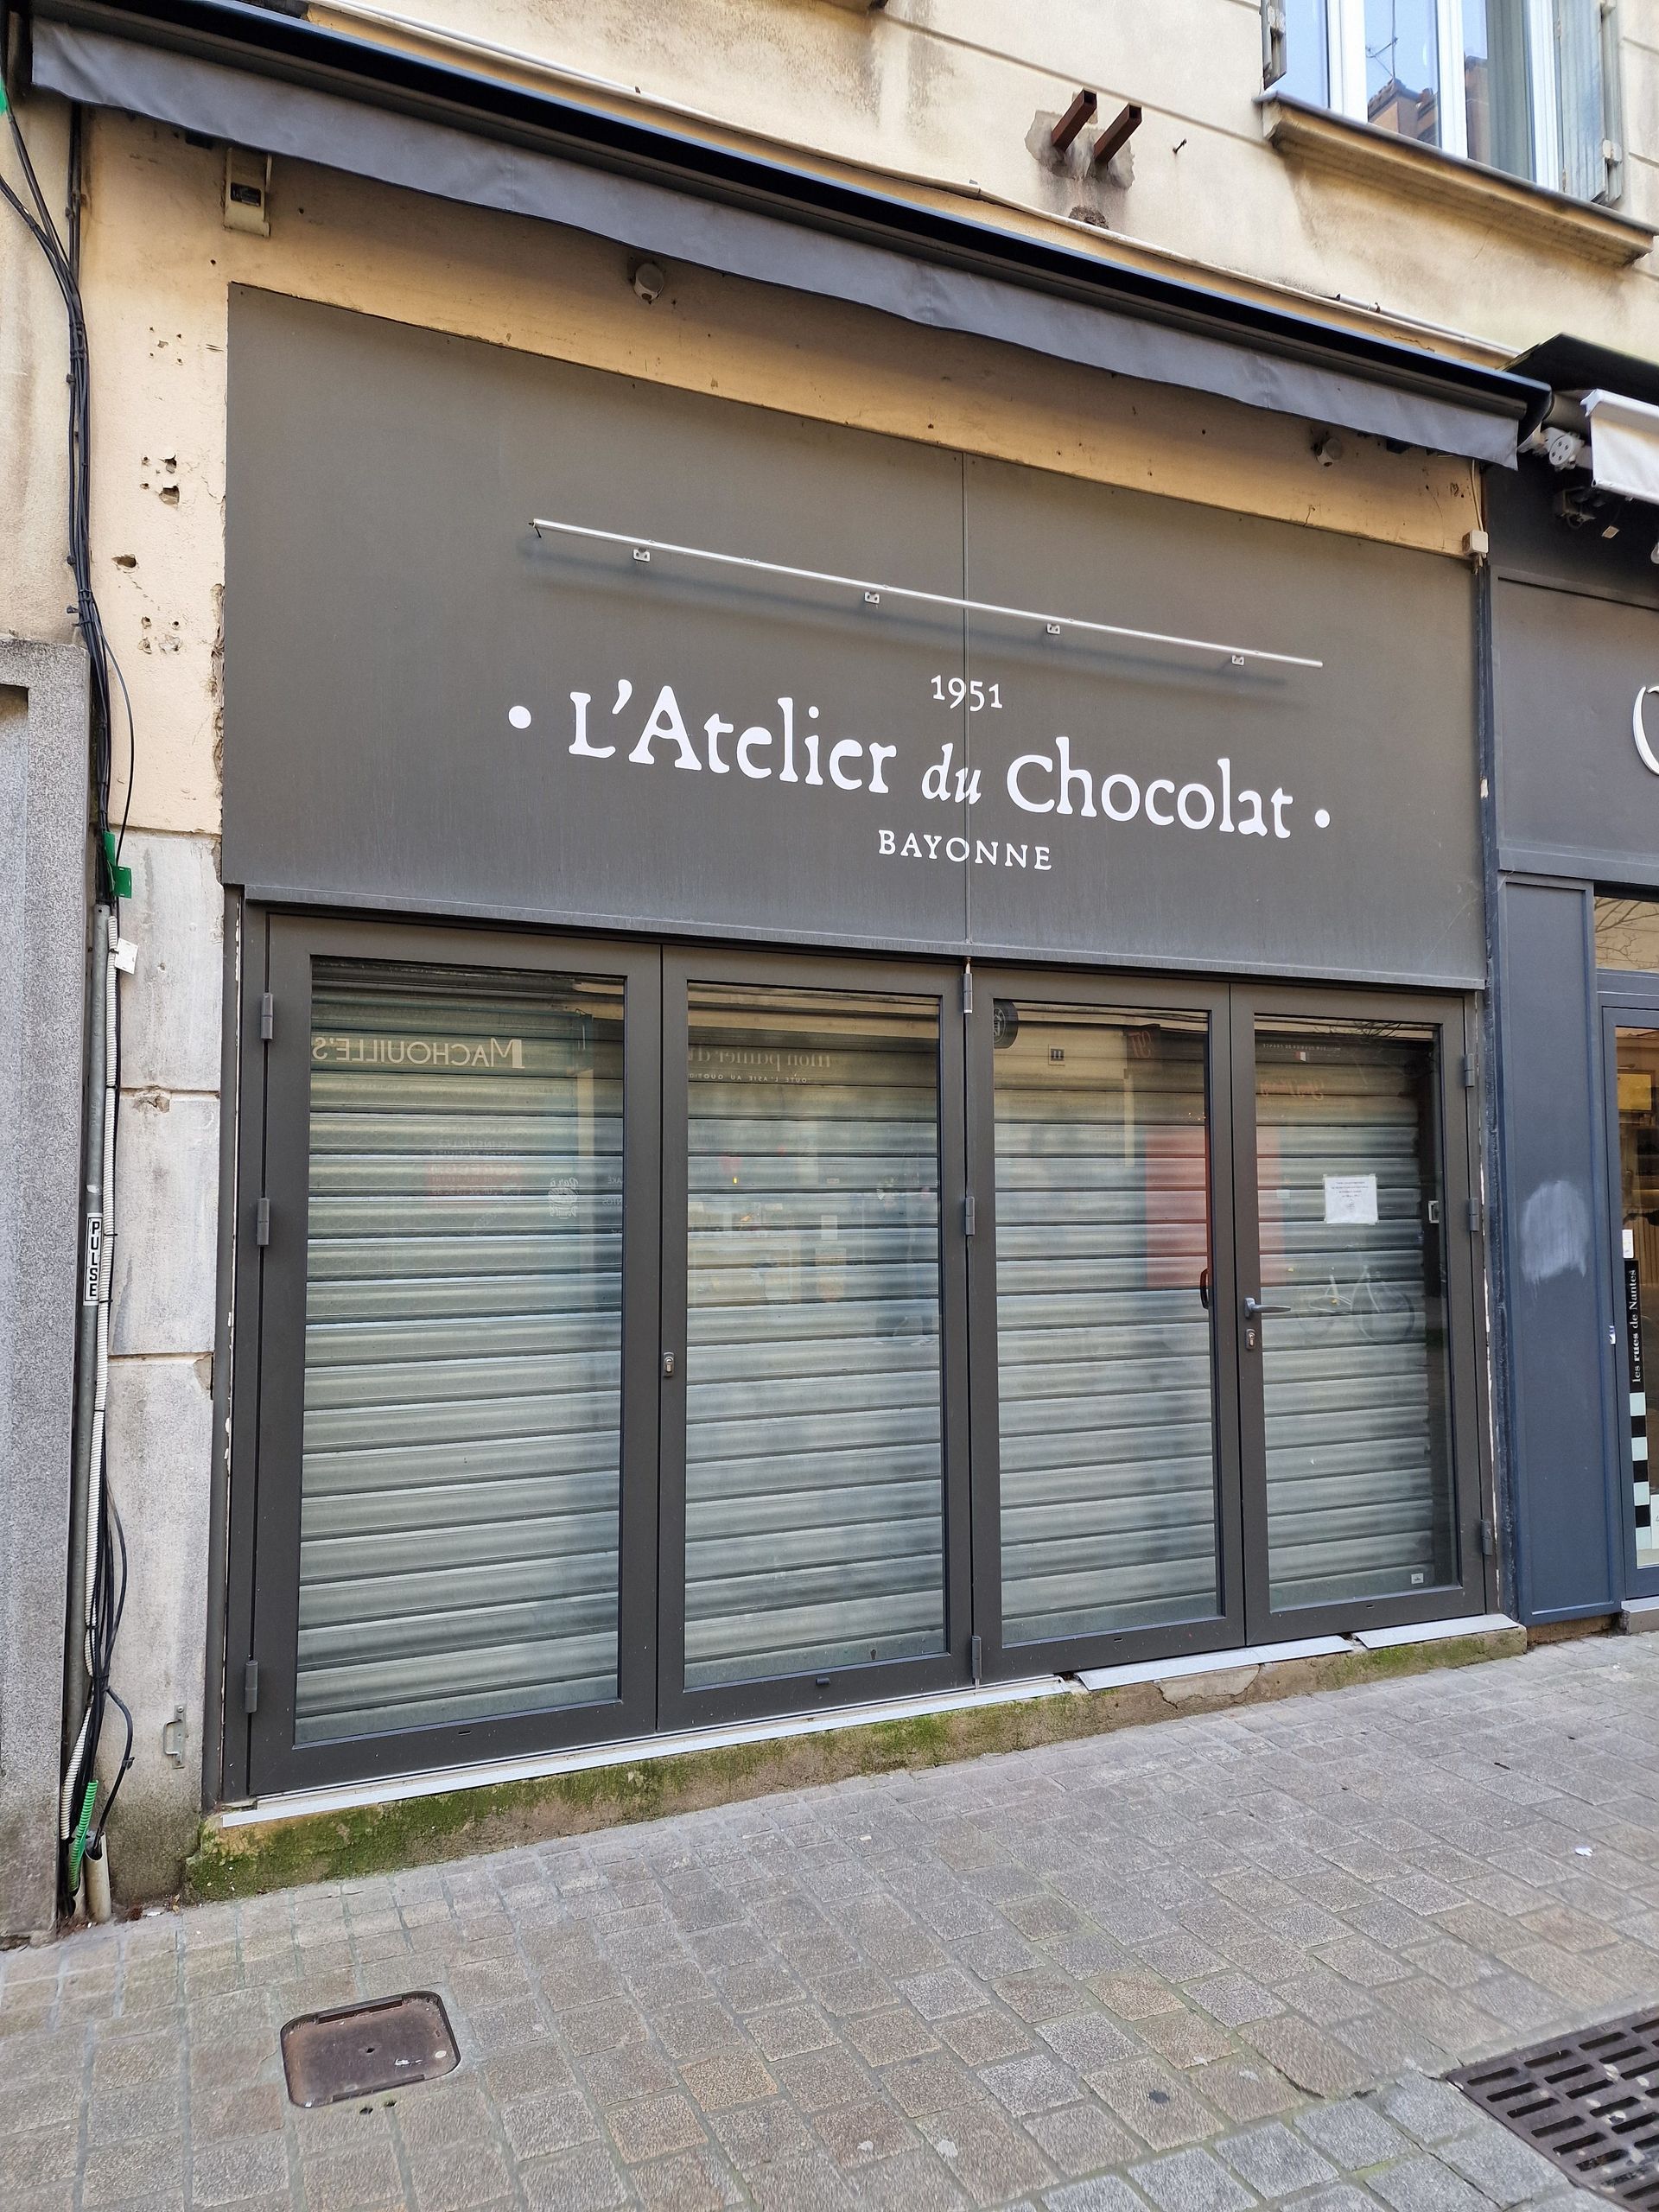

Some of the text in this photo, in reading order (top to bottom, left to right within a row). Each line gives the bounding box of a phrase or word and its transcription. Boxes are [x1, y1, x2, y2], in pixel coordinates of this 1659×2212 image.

[931, 674, 1003, 712] 1951
[568, 678, 1294, 839] L'Atelier du Chocolat
[878, 829, 1052, 871] BAYONNE
[89, 1221, 100, 1297] PULSE
[1628, 1269, 1637, 1310] Nantes
[1629, 1313, 1638, 1329] de
[1631, 1365, 1641, 1382] les
